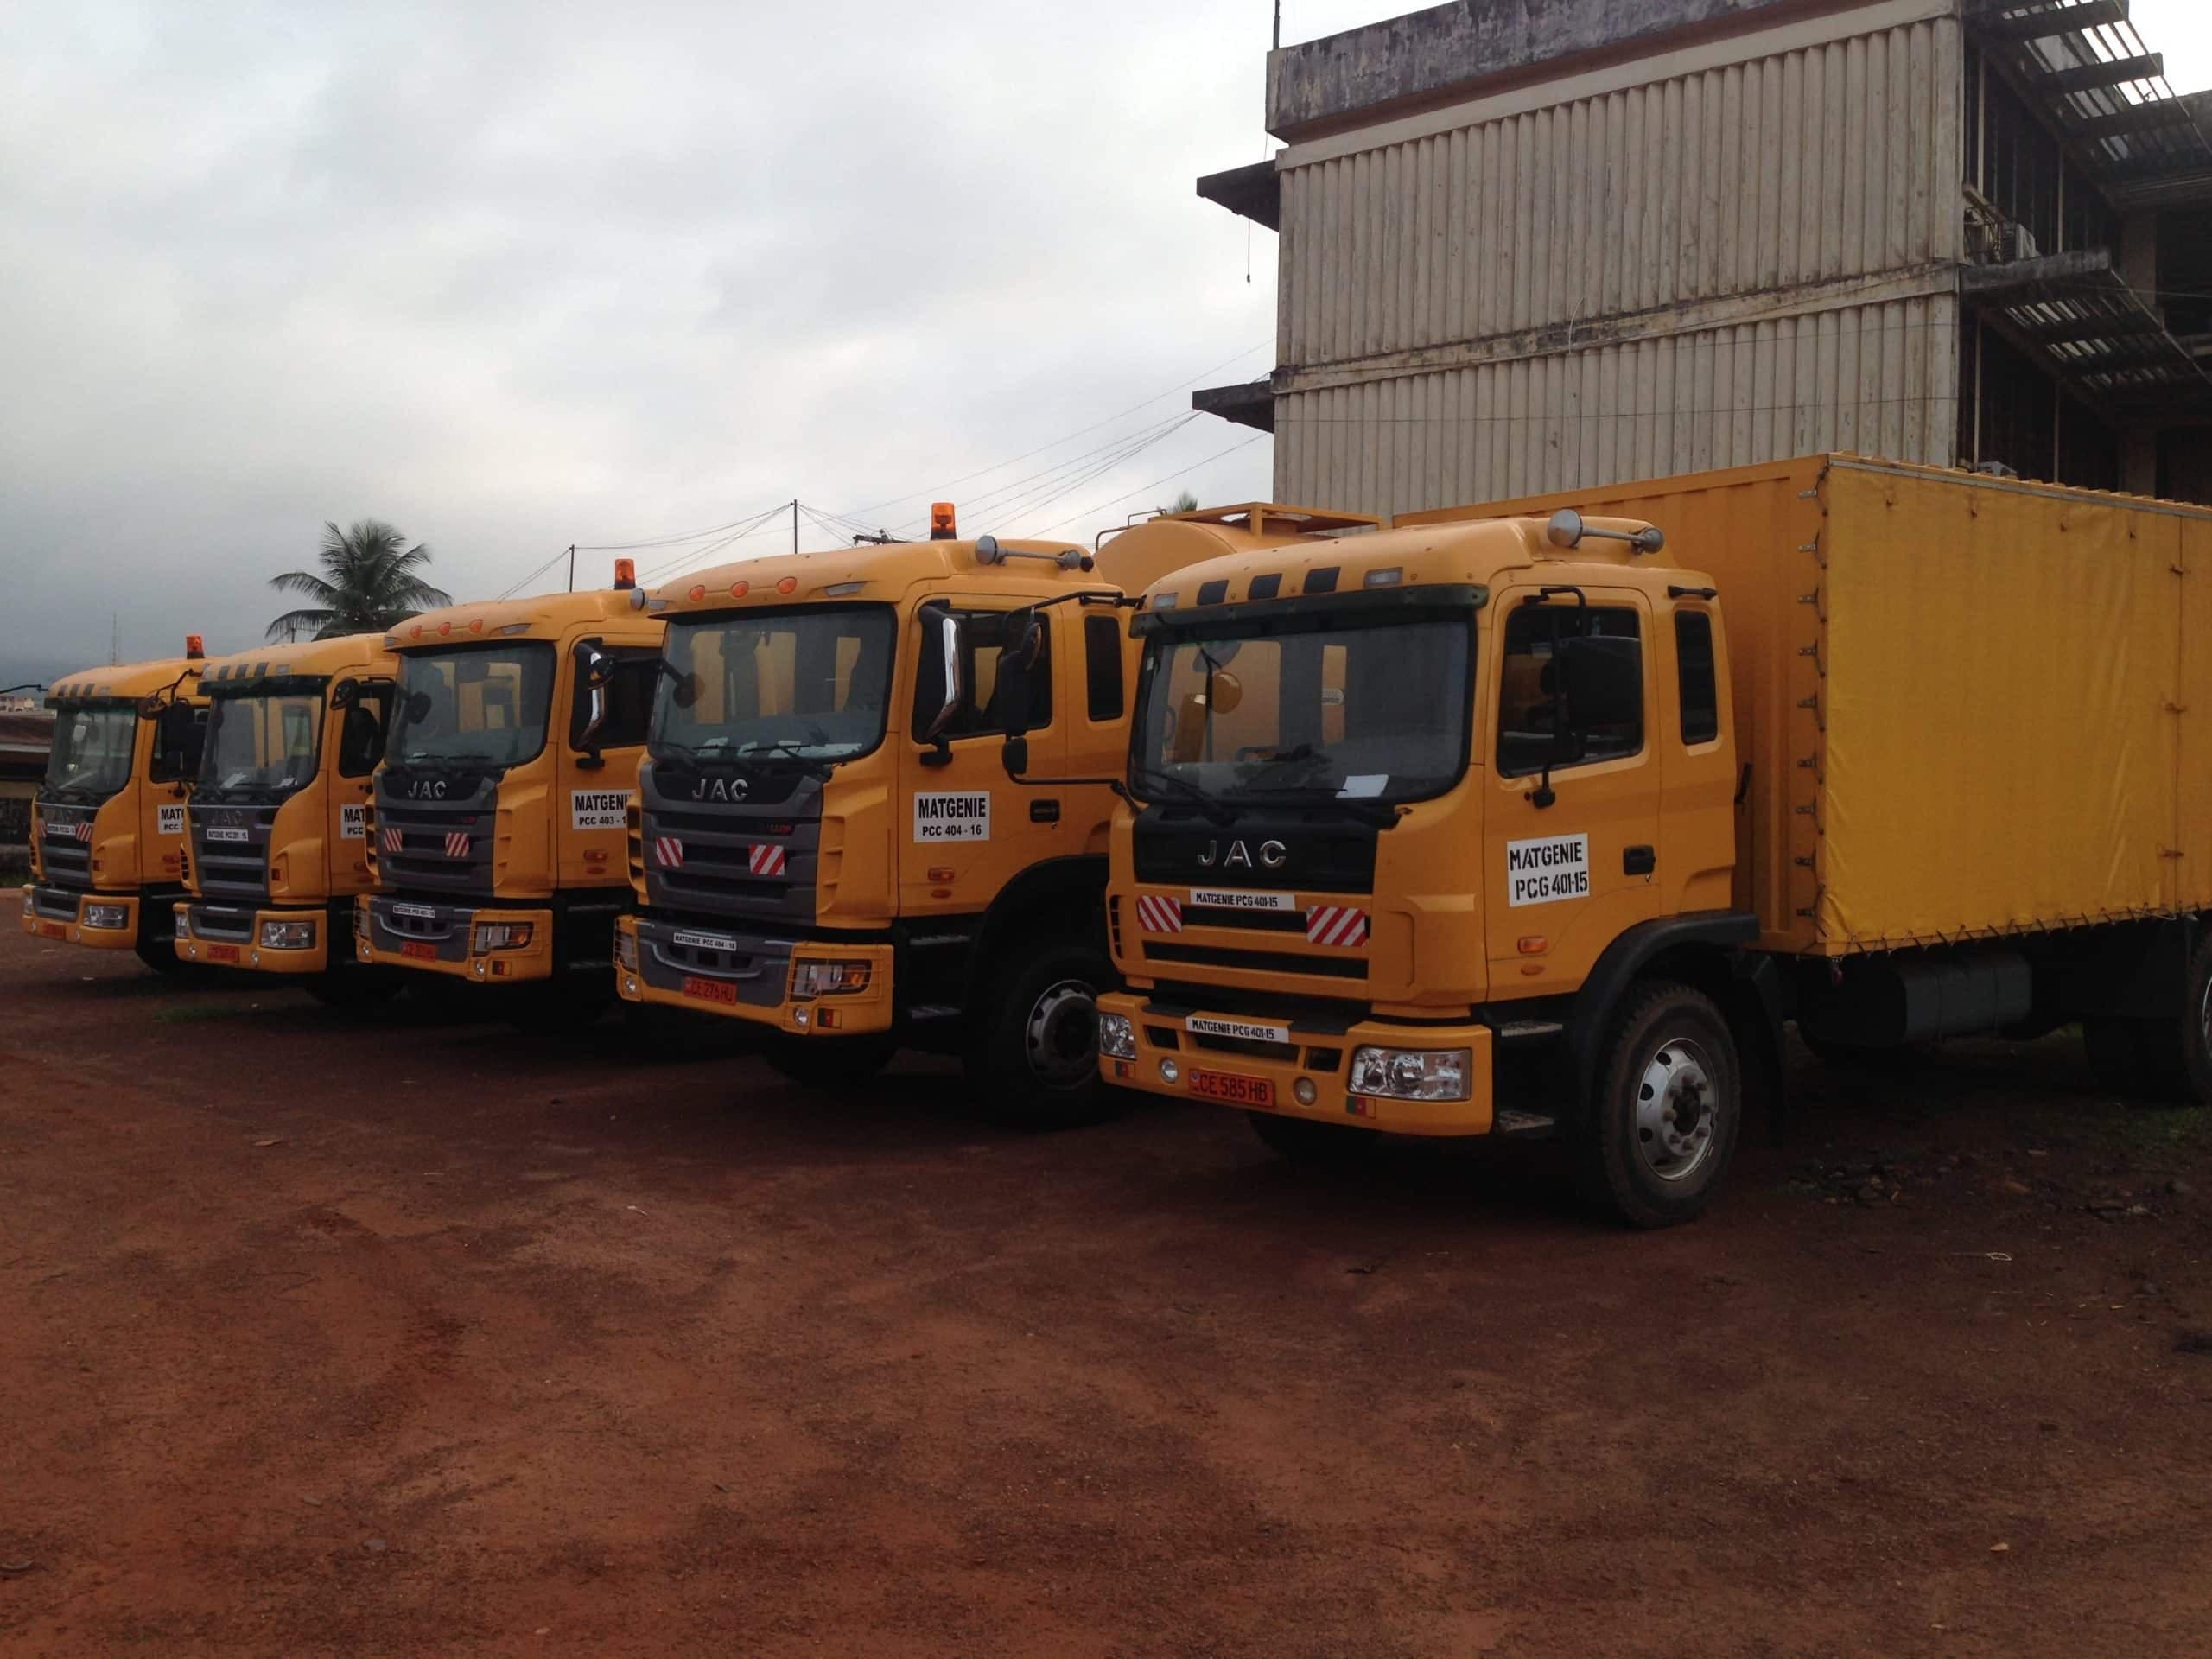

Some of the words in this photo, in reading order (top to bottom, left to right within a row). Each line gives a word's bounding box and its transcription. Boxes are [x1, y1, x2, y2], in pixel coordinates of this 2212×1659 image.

[407, 780, 447, 799] JAC
[691, 779, 748, 802] JAC
[575, 793, 632, 811] MATGENI
[918, 798, 987, 819] MATGENIE
[579, 817, 596, 825] PCC
[599, 816, 615, 824] 403
[922, 825, 942, 836] PCC
[944, 825, 963, 836] 404
[970, 824, 982, 836] 16
[1197, 839, 1287, 868] JAC
[1509, 842, 1583, 871] MATGENIE
[1516, 875, 1549, 901] PCG
[1196, 892, 1236, 906] MATGENIE
[1236, 894, 1253, 906] PCG
[1192, 1019, 1231, 1035] MATGENIE
[1232, 1024, 1249, 1037] PCG
[1200, 1074, 1217, 1094] CE
[1220, 1077, 1246, 1099] 585
